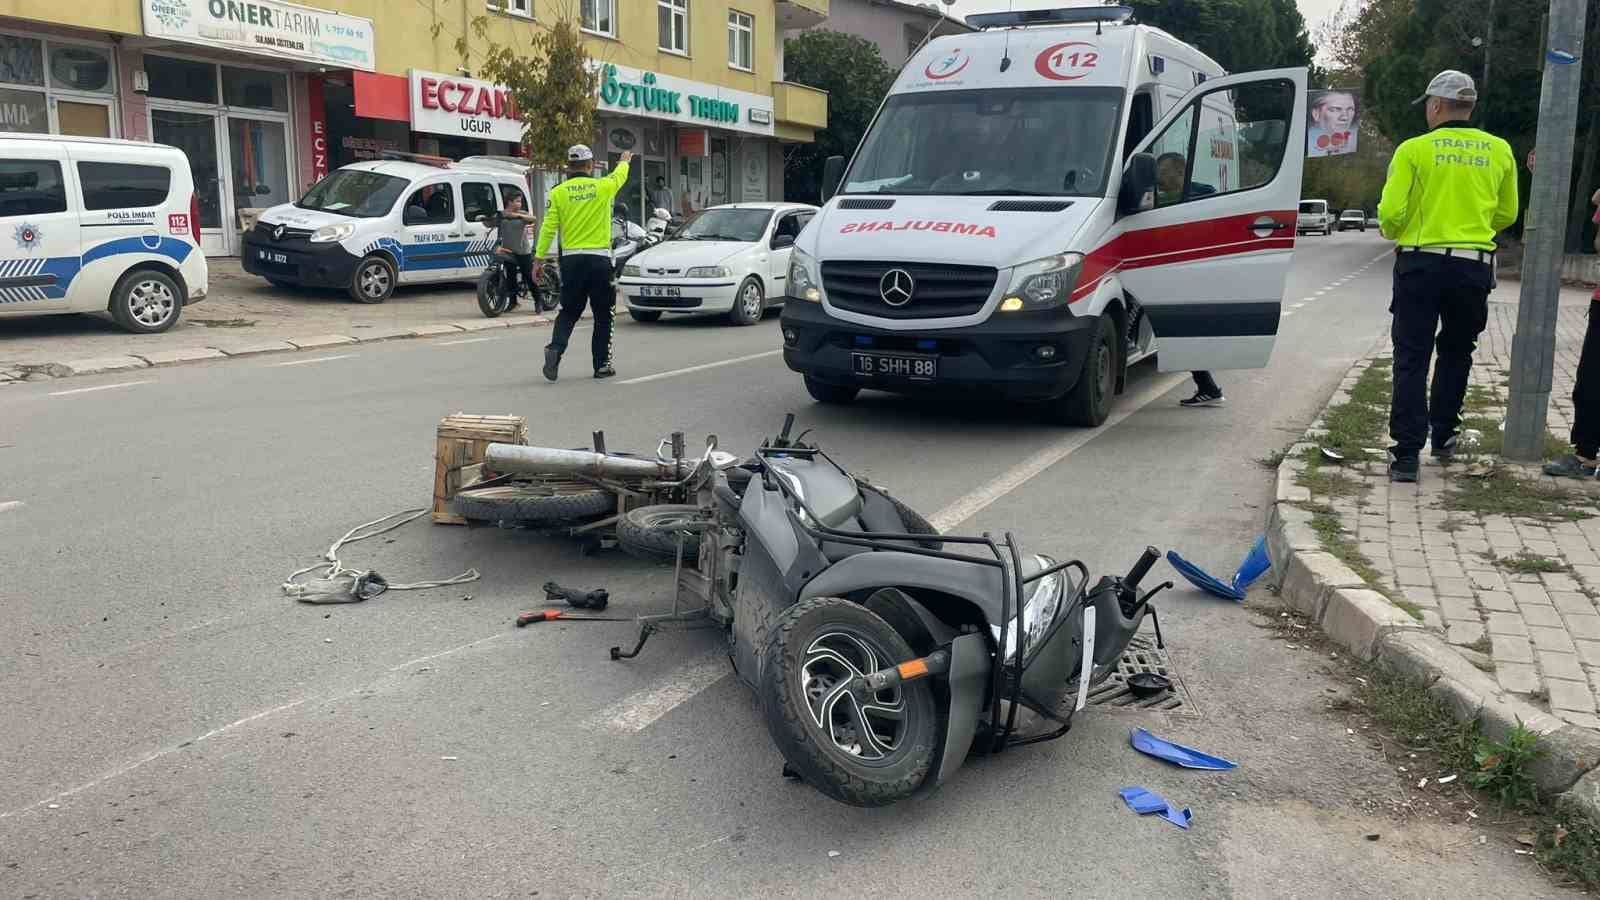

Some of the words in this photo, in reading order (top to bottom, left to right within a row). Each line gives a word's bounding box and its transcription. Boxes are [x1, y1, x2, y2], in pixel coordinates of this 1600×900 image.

[1052, 52, 1098, 68] 112
[600, 63, 681, 113] ÖZTÜRK
[688, 95, 739, 123] TARIM
[460, 117, 492, 134] UĞUR
[170, 215, 187, 227] 112
[860, 356, 872, 371] 16
[880, 358, 910, 374] SHH
[914, 360, 934, 376] 88
